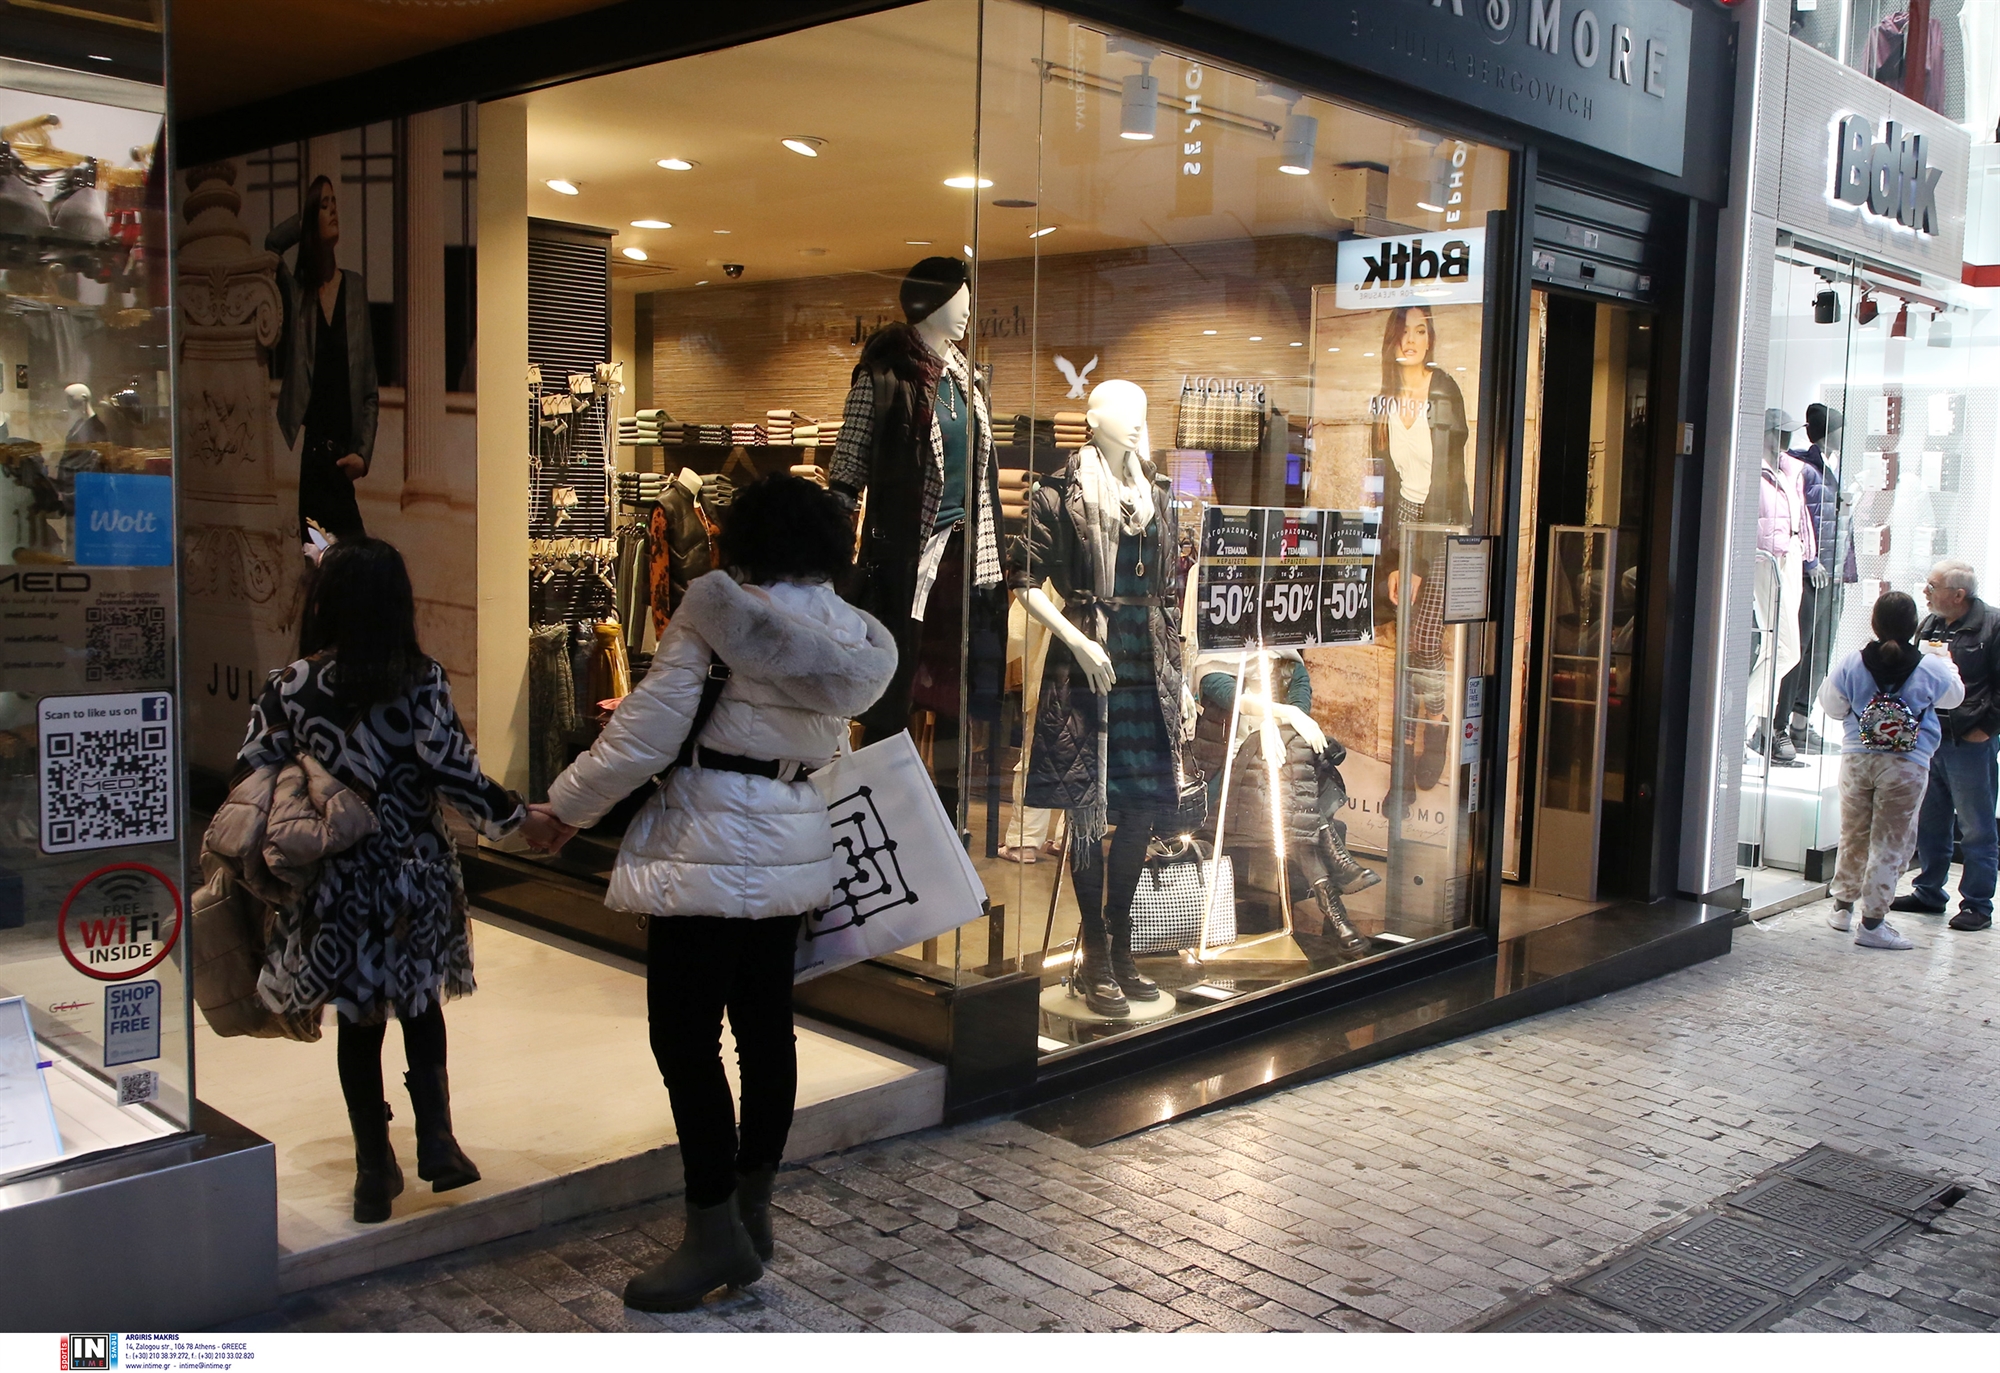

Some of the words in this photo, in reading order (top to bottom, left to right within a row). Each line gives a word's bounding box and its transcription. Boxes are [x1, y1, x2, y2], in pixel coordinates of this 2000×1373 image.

[1389, 24, 1457, 71] JULIA
[1467, 53, 1593, 121] BERGOVICH
[90, 508, 157, 533] Wolt
[1217, 538, 1224, 556] 2
[1337, 539, 1343, 556] 2
[1201, 585, 1255, 625] -50%
[1266, 583, 1314, 623] -50%
[1324, 583, 1368, 620] -50%
[45, 711, 70, 720] Scan
[87, 709, 106, 717] like
[124, 708, 137, 716] on
[81, 778, 136, 793] MED
[103, 902, 140, 917] FREE
[80, 912, 159, 949] WiFi
[90, 943, 152, 964] INSIDE
[110, 985, 155, 1004] SHOP
[110, 1002, 142, 1019] TAX
[110, 1016, 150, 1035] FREE
